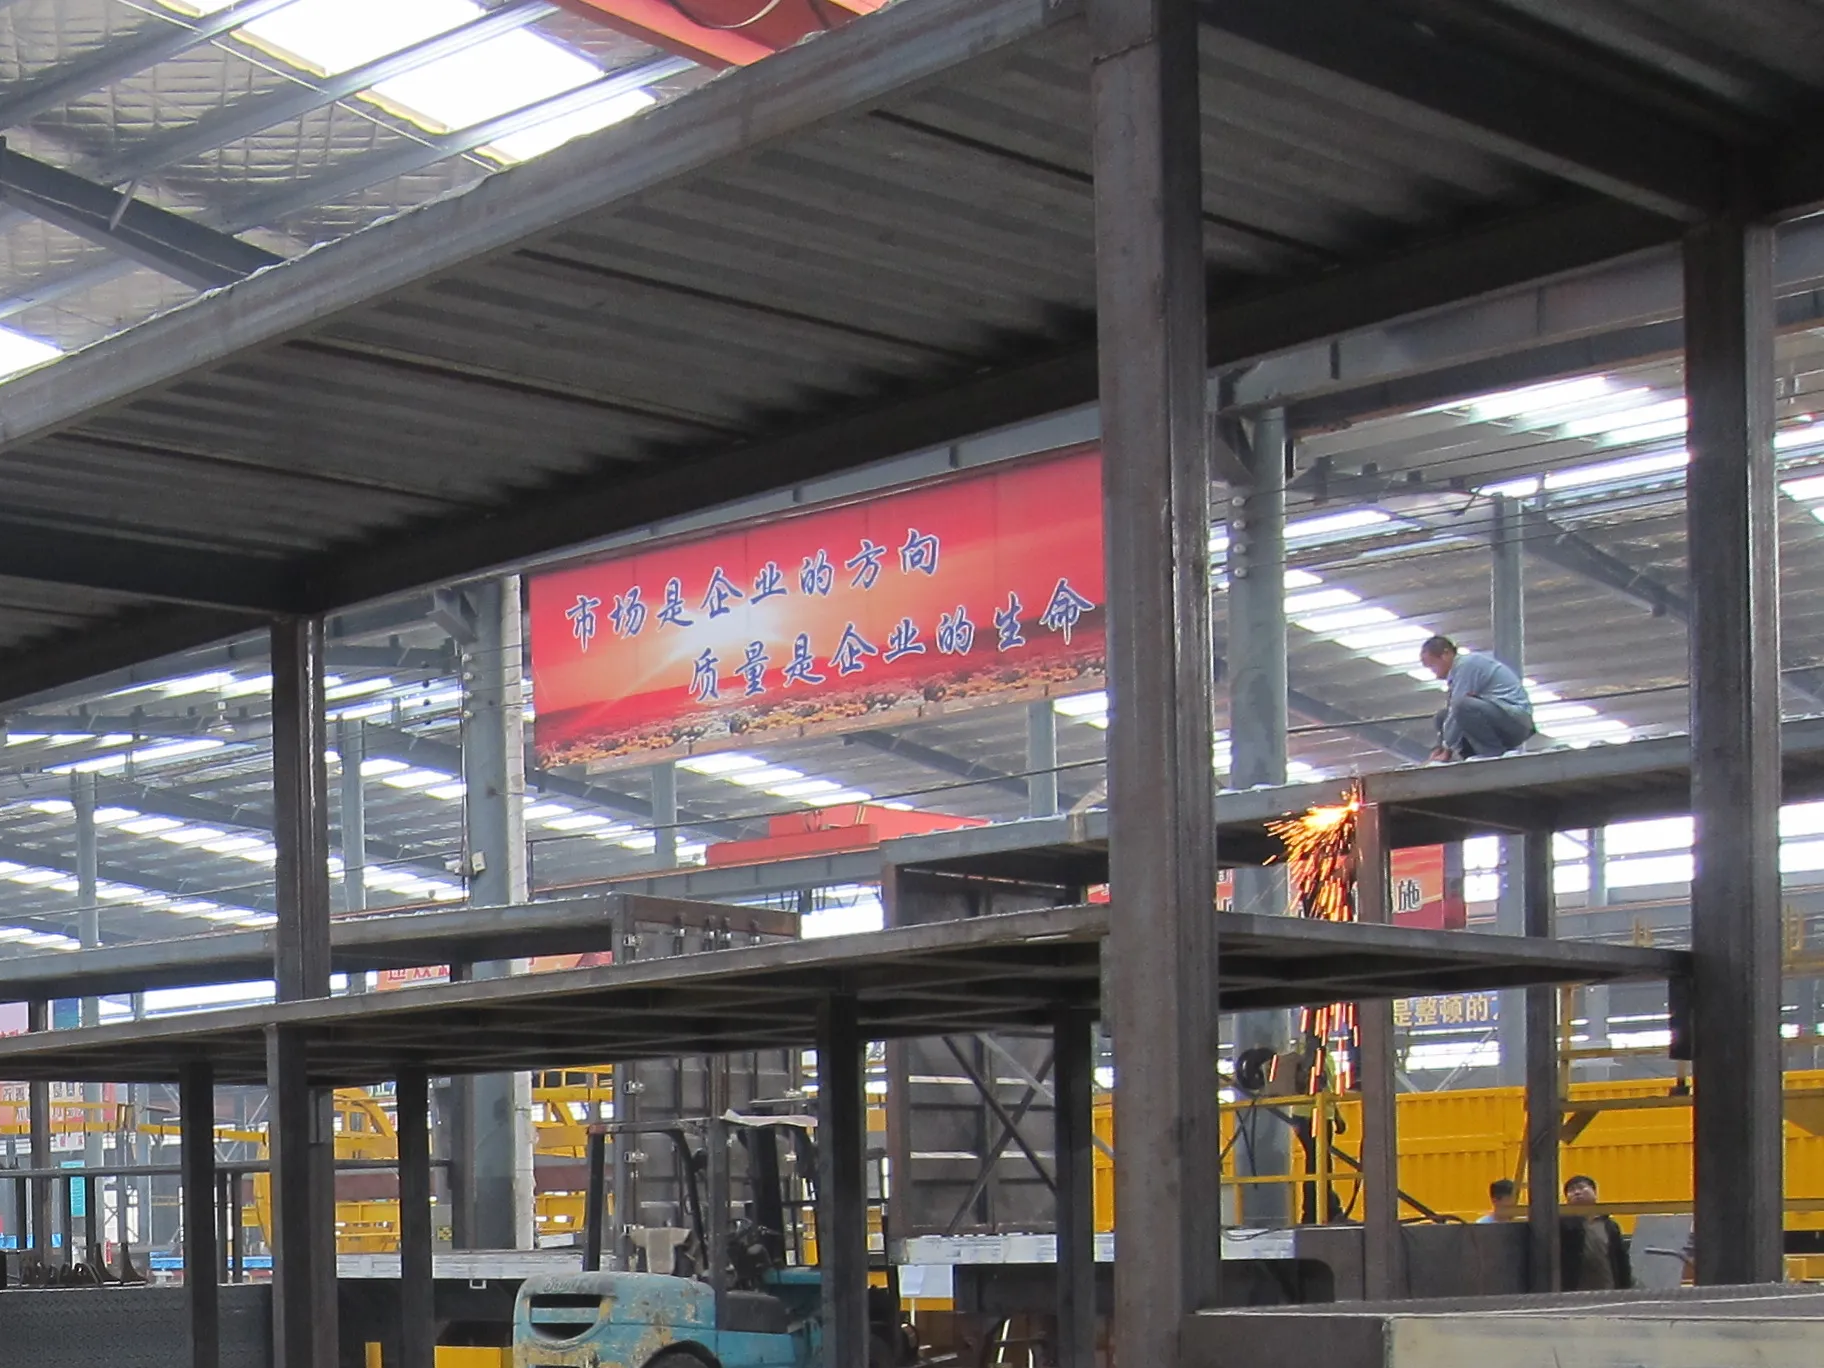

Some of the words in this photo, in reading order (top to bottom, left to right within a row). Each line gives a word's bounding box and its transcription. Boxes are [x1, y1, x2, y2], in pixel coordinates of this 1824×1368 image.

[565, 527, 941, 652] 市场是企业的方向
[687, 577, 1096, 702] 质量是企业的生命
[1393, 994, 1499, 1026] 是整顿的
